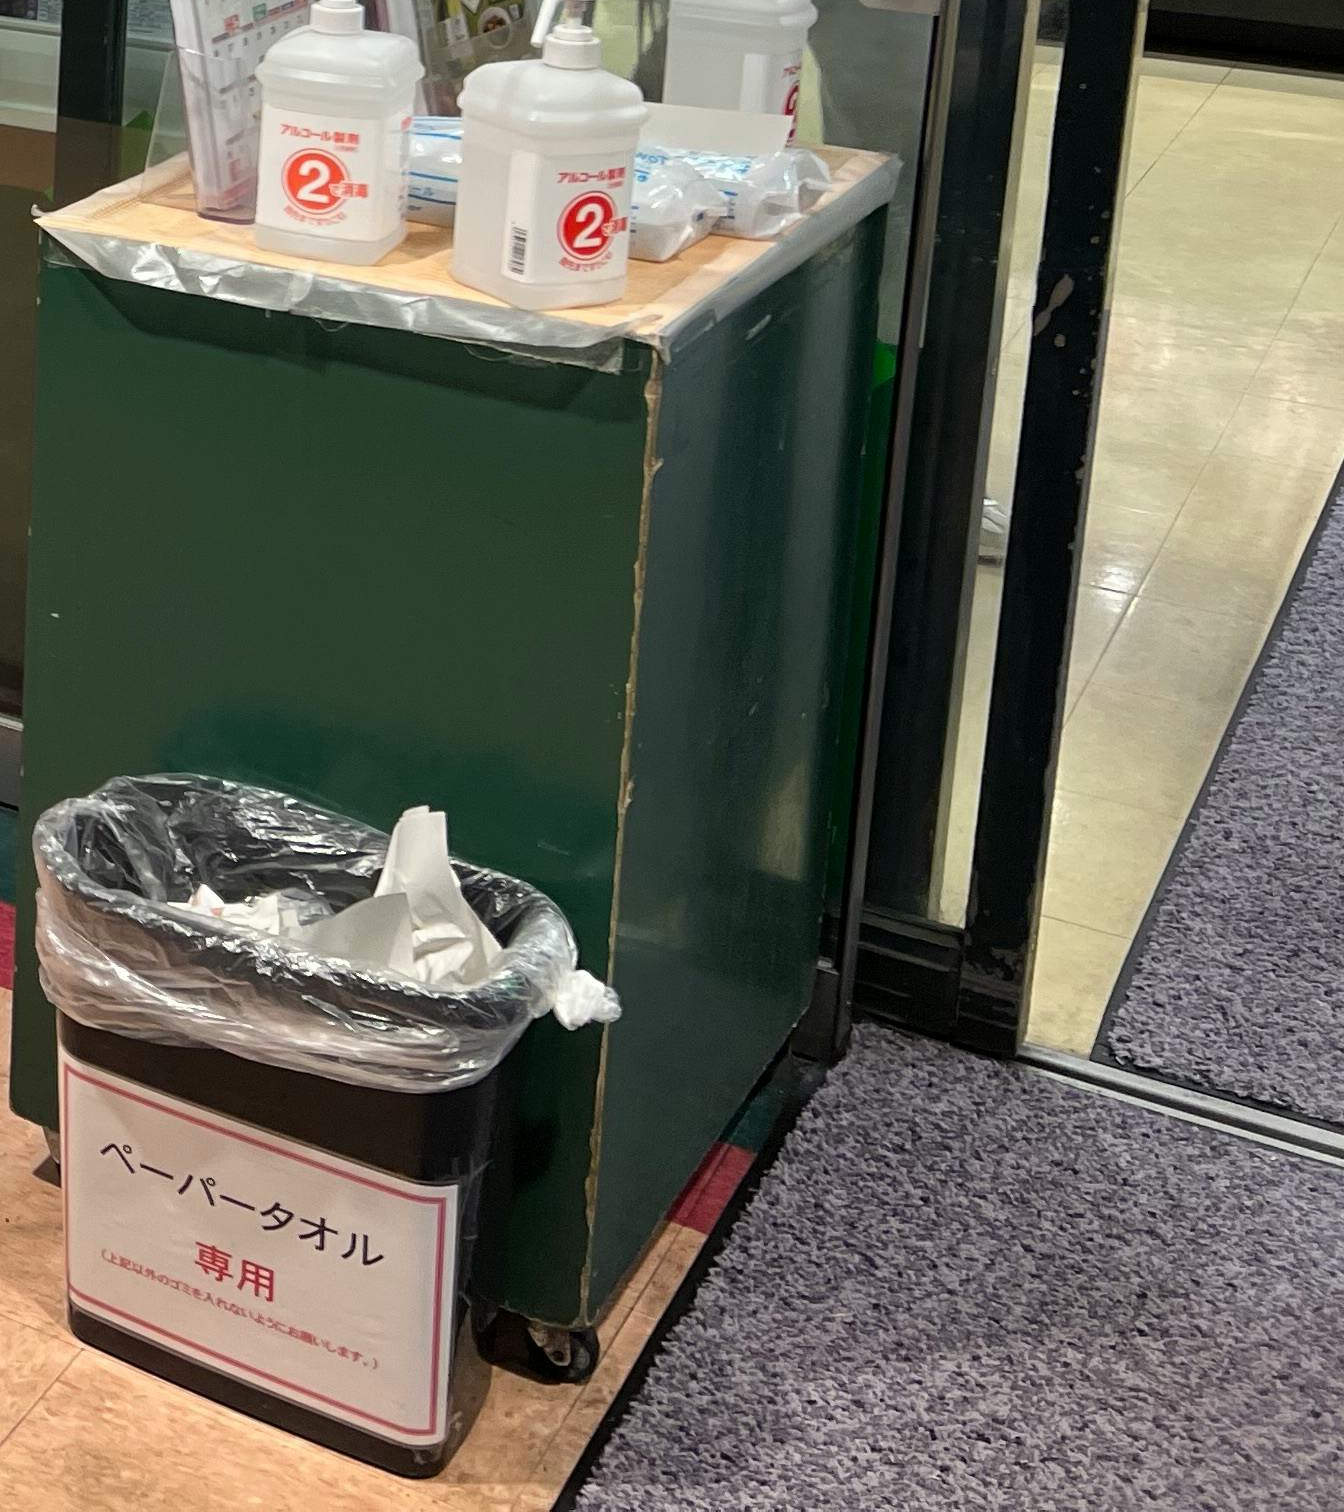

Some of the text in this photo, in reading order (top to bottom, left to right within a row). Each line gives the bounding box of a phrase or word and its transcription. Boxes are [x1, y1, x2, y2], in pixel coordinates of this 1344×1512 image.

[279, 123, 360, 145] アルコール製剤
[296, 159, 331, 204] 2
[572, 202, 605, 249] 2
[99, 1139, 385, 1271] ペーパータオル
[194, 1240, 276, 1303] 専用
